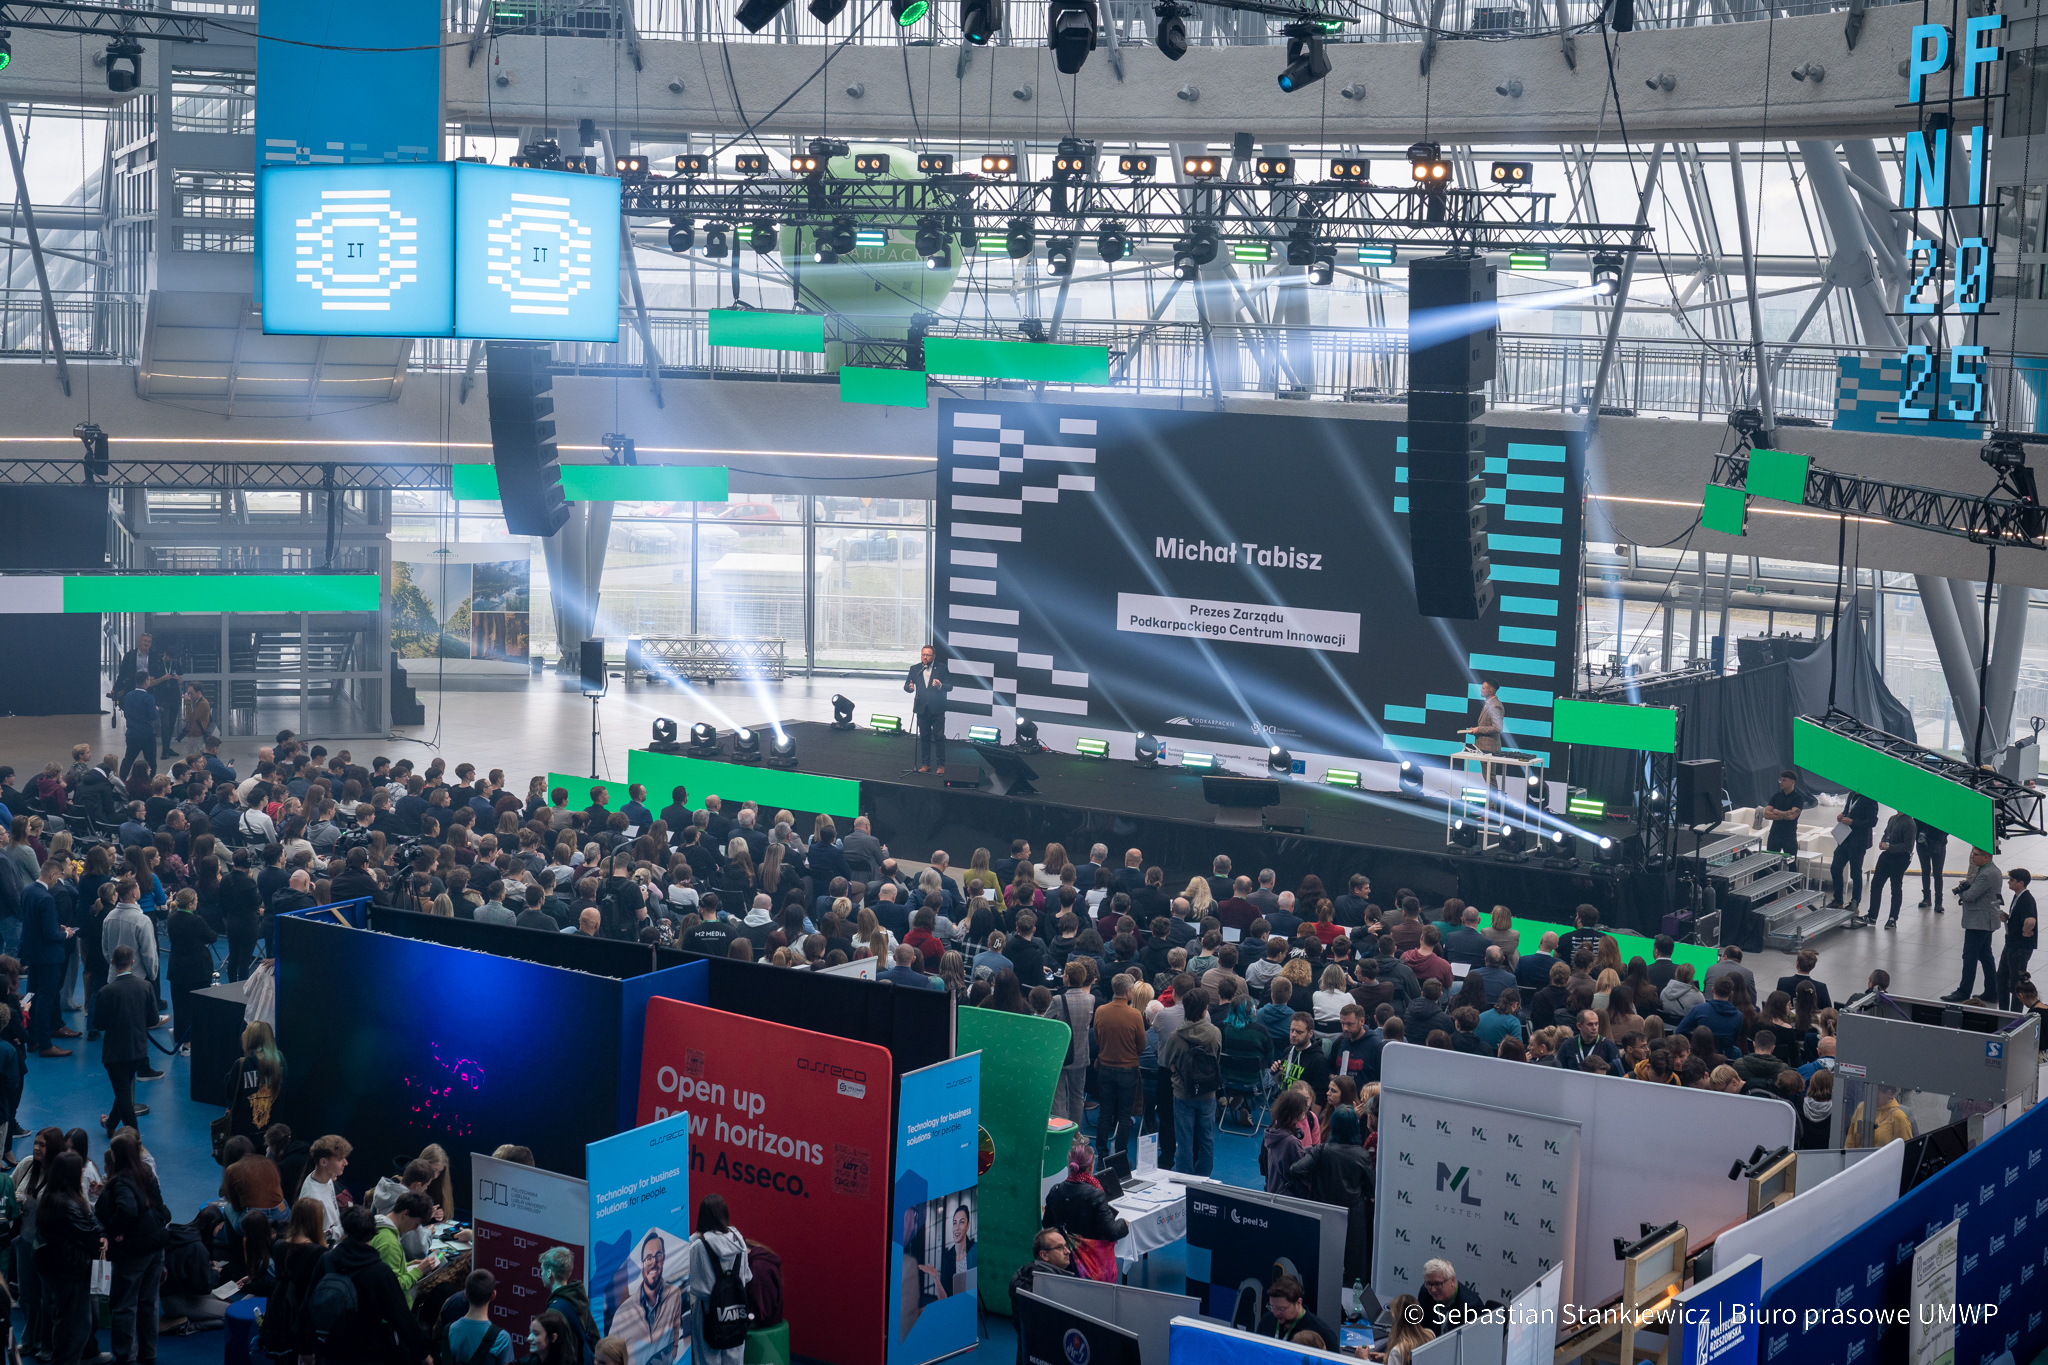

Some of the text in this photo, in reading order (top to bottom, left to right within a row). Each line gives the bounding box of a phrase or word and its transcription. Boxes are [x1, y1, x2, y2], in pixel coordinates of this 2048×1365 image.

[1908, 14, 2002, 102] PF
[1904, 126, 1984, 208] NI
[348, 242, 364, 258] IT
[533, 247, 548, 262] IT
[1904, 238, 1989, 314] 20
[1899, 345, 1986, 421] 25
[1156, 536, 1322, 570] Michał Tabisz
[1190, 605, 1284, 624] Prezes Zarządu
[1130, 615, 1346, 647] Podkarpackiego Centrum Innowacji
[1192, 717, 1236, 728] PODKARPACKIE
[1263, 725, 1276, 734] PCI
[797, 1058, 867, 1082] asseco
[946, 1076, 972, 1089] asseco
[657, 1066, 766, 1119] Open up
[907, 1118, 940, 1134] Technology
[949, 1108, 972, 1121] business
[650, 1129, 684, 1147] asseco
[715, 1113, 824, 1165] horizons
[907, 1132, 931, 1146] solutions
[596, 1167, 680, 1204] Technology for business
[712, 1152, 810, 1198] Asseco.
[1436, 1161, 1481, 1207] ML
[596, 1200, 628, 1219] solutions
[629, 1197, 640, 1206] for
[1156, 1214, 1174, 1225] Google
[1194, 1201, 1268, 1228] DPS peel 3d
[1435, 1204, 1481, 1219] SYSTEM
[717, 1304, 747, 1322] VANS
[1710, 1325, 1742, 1352] RZESZOWSKA
